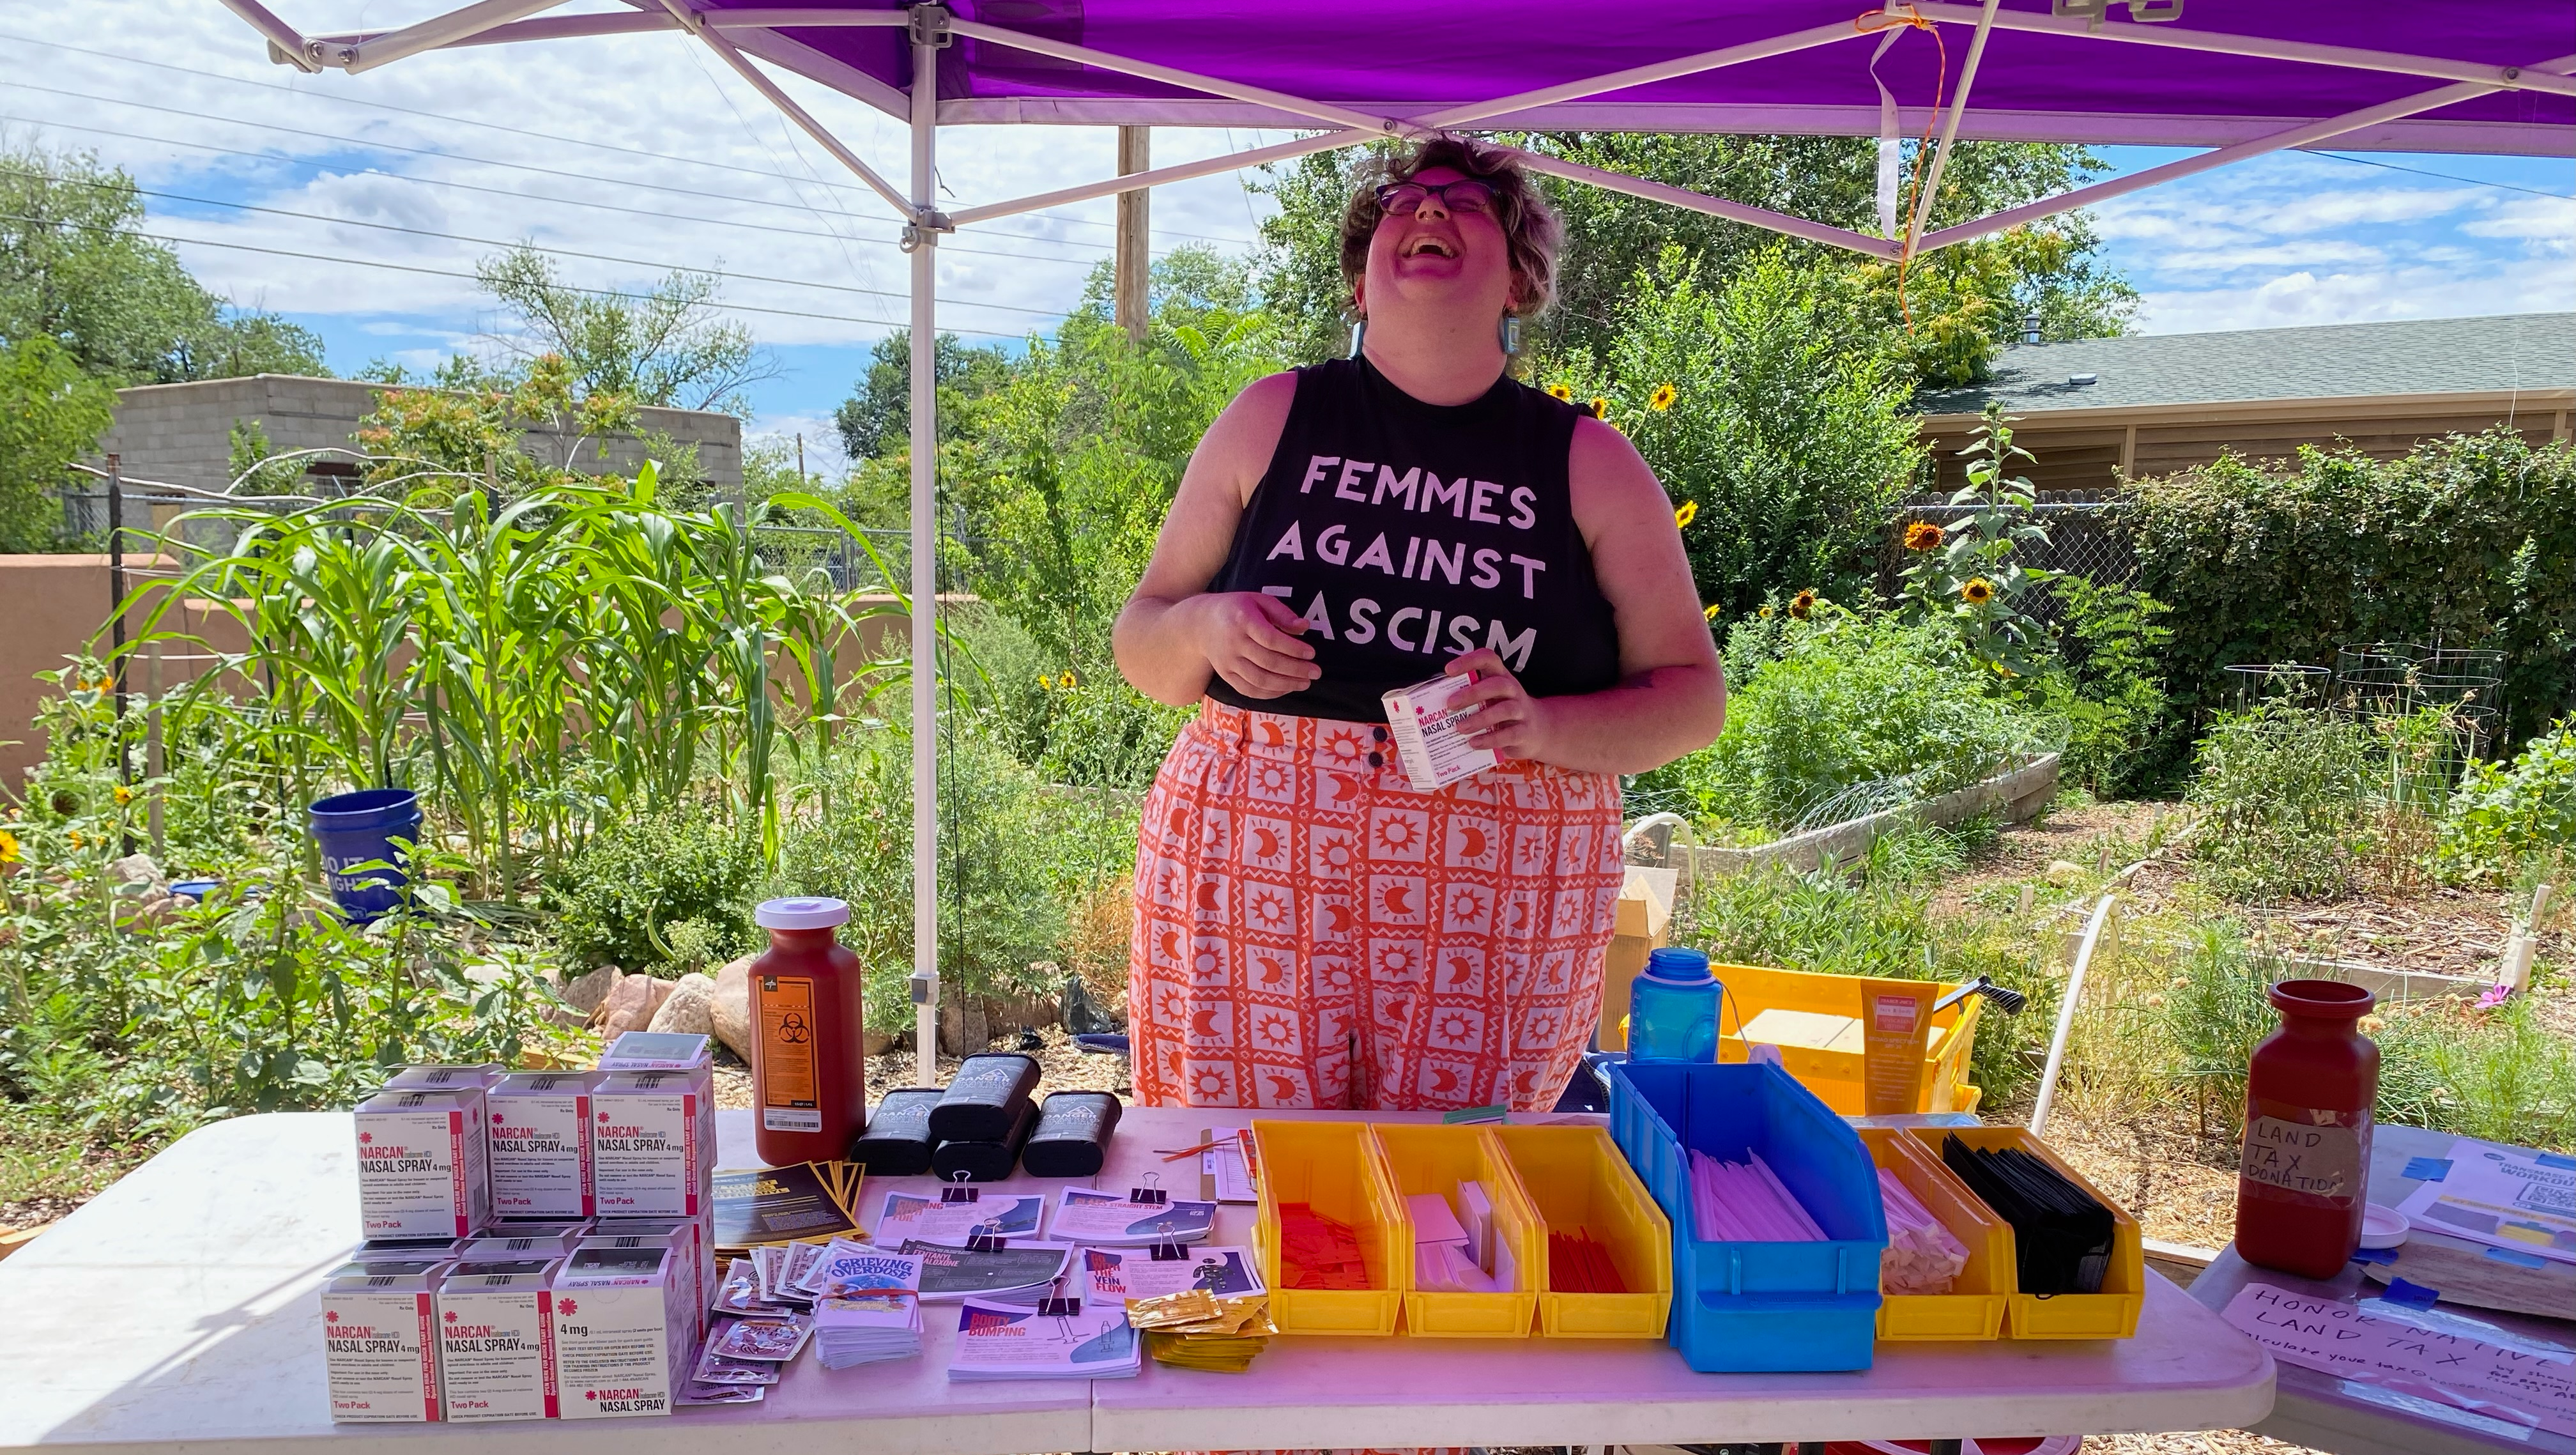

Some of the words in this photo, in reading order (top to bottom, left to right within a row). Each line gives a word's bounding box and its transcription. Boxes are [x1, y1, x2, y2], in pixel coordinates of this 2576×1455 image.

[1300, 454, 1537, 530] FEMMES
[1266, 519, 1546, 599] AGAINST
[1422, 722, 1446, 738] NASAL
[1436, 770, 1448, 778] Two
[1448, 764, 1461, 775] Pack
[328, 875, 369, 892] IGHT
[2257, 1121, 2322, 1148] LAND
[493, 1140, 526, 1152] NASAL
[528, 1140, 560, 1152] SPRAY
[597, 1139, 631, 1151] NASAL
[633, 1139, 666, 1151] SPRAY
[671, 1144, 684, 1153] mg
[2250, 1143, 2302, 1173] TAX
[361, 1160, 396, 1173] NASAL
[398, 1159, 432, 1173] SPRAY
[439, 1164, 451, 1173] mg
[2501, 1167, 2575, 1187] WORKOU
[383, 1220, 402, 1228] Pack
[912, 1249, 952, 1260] FENTANYL
[835, 1257, 914, 1273] GRIEVING
[923, 1258, 960, 1267] ALOXONE
[831, 1265, 912, 1280] OVERDOSE
[1094, 1275, 1121, 1286] VEIN
[1096, 1282, 1126, 1293] FLOW
[2255, 1289, 2377, 1327] HONOR
[560, 1324, 567, 1334] 4
[569, 1325, 588, 1337] mg
[969, 1326, 1026, 1337] BUMPING
[445, 1339, 482, 1353] NASAL
[485, 1338, 520, 1351] SPRAY
[527, 1343, 539, 1351] mg
[2239, 1328, 2320, 1355] alculate
[2256, 1311, 2361, 1340] LAND
[2387, 1337, 2467, 1366] TAX
[328, 1340, 364, 1353] NASAL
[365, 1340, 400, 1353] SPRAY
[407, 1345, 420, 1354] mg
[334, 1401, 349, 1409] Two
[351, 1401, 371, 1409] Pack
[450, 1401, 467, 1409] Two
[469, 1400, 489, 1408] Pack
[600, 1401, 632, 1413] NASAL
[634, 1398, 665, 1412] SPRAY
